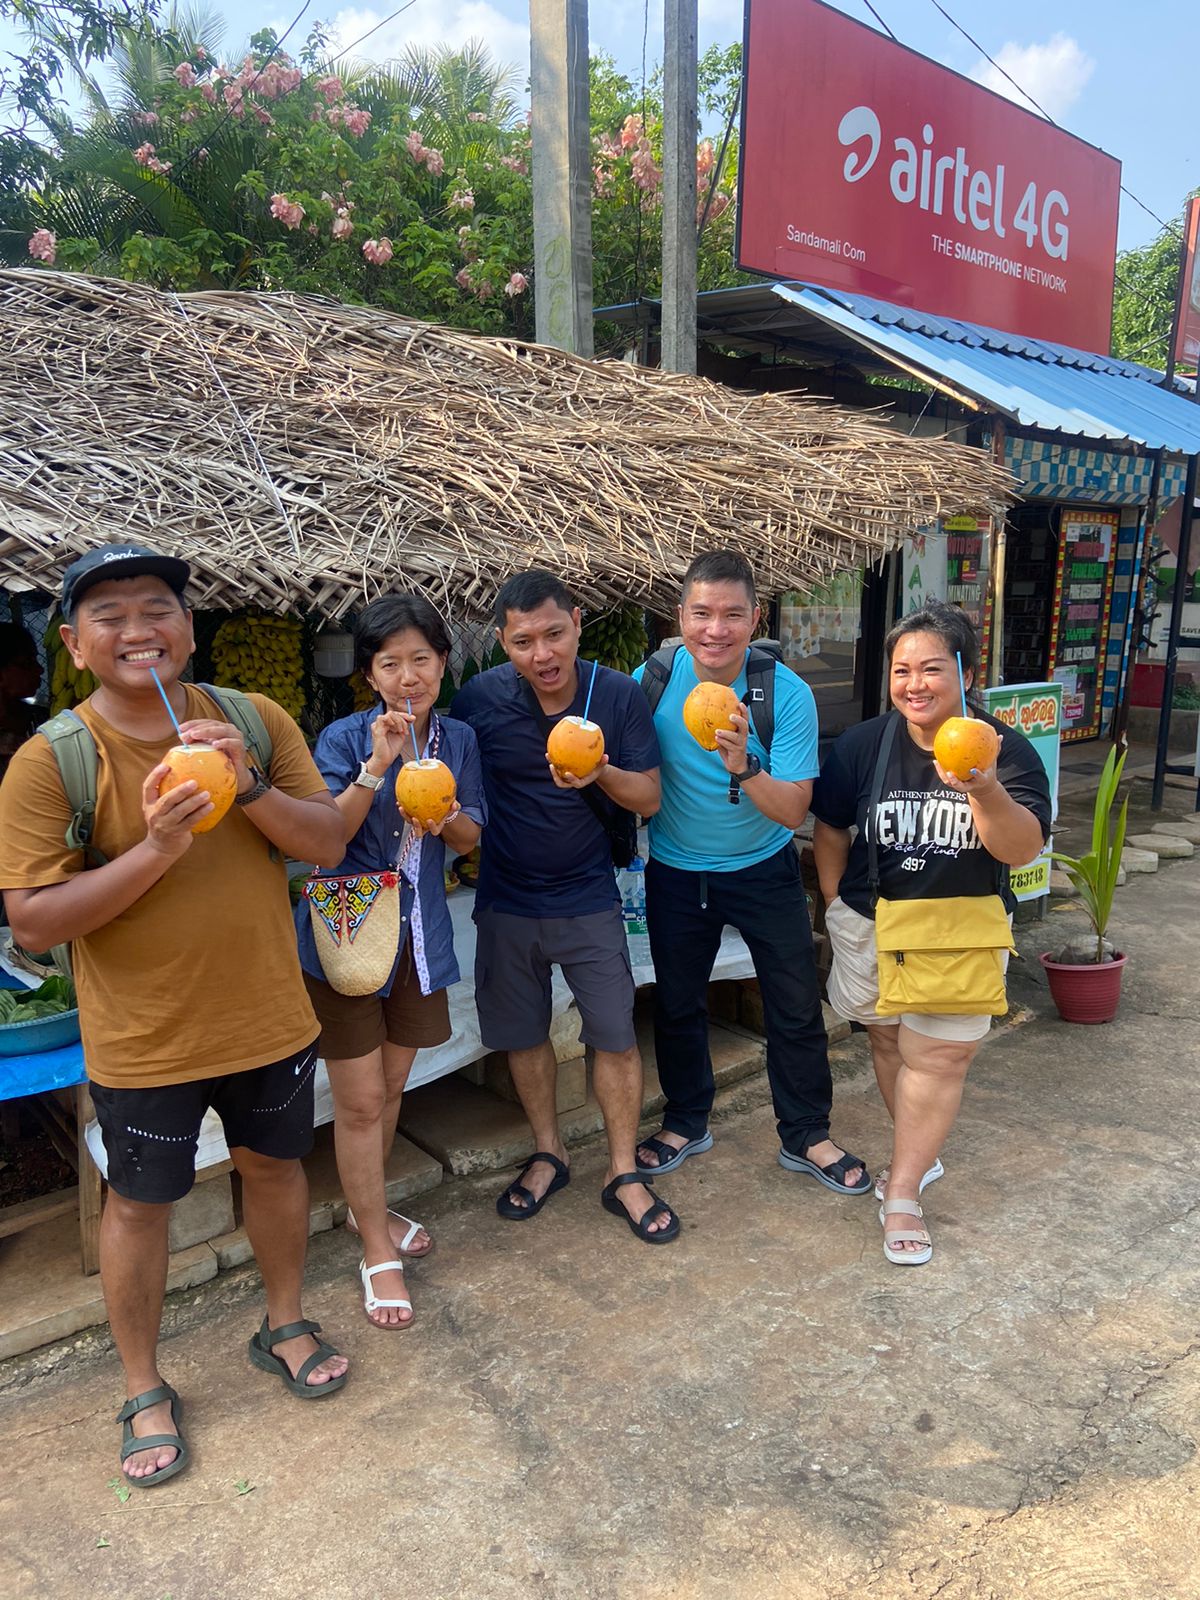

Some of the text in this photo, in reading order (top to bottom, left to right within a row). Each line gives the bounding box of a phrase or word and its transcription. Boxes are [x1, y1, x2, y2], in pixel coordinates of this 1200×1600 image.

[889, 123, 1070, 262] airtel 4G
[786, 224, 866, 263] Sandamali Com
[931, 234, 1068, 294] THE SMARTPHONE NETWORK
[887, 789, 967, 801] AUTHENTIC LAYERS
